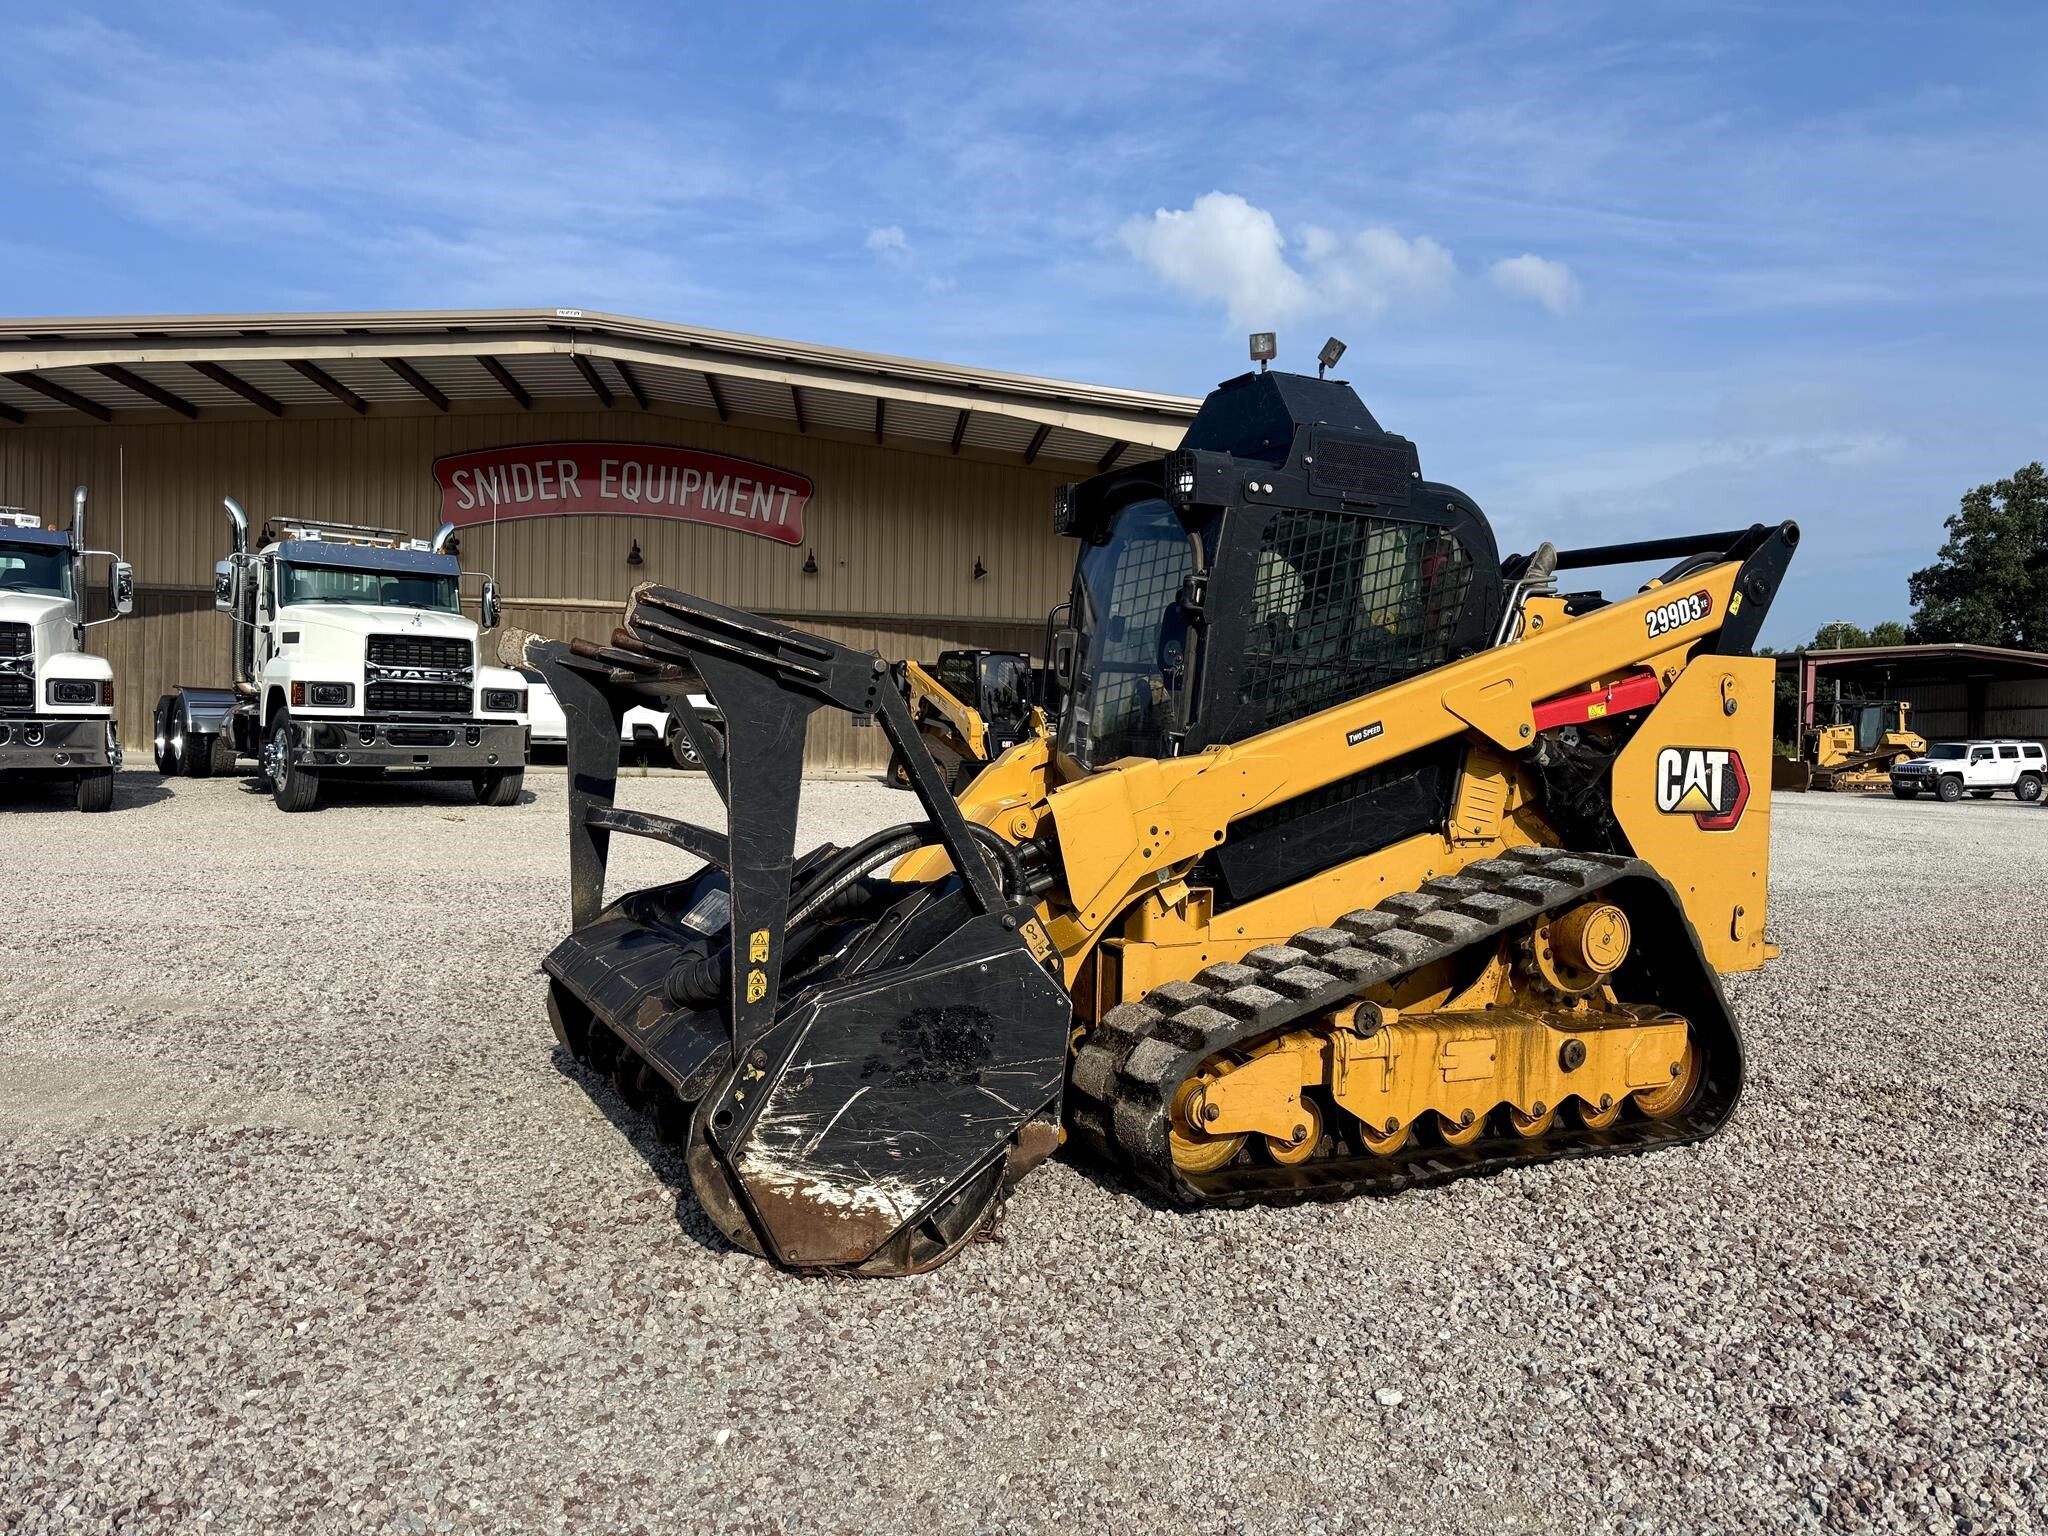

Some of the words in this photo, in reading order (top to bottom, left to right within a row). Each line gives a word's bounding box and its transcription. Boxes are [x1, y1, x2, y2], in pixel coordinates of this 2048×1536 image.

[451, 459, 582, 510] SNIDER
[600, 458, 798, 526] EQUIPMENT
[1645, 593, 1702, 638] 299D3
[379, 669, 459, 682] MACK
[1657, 748, 1729, 812] CAT
